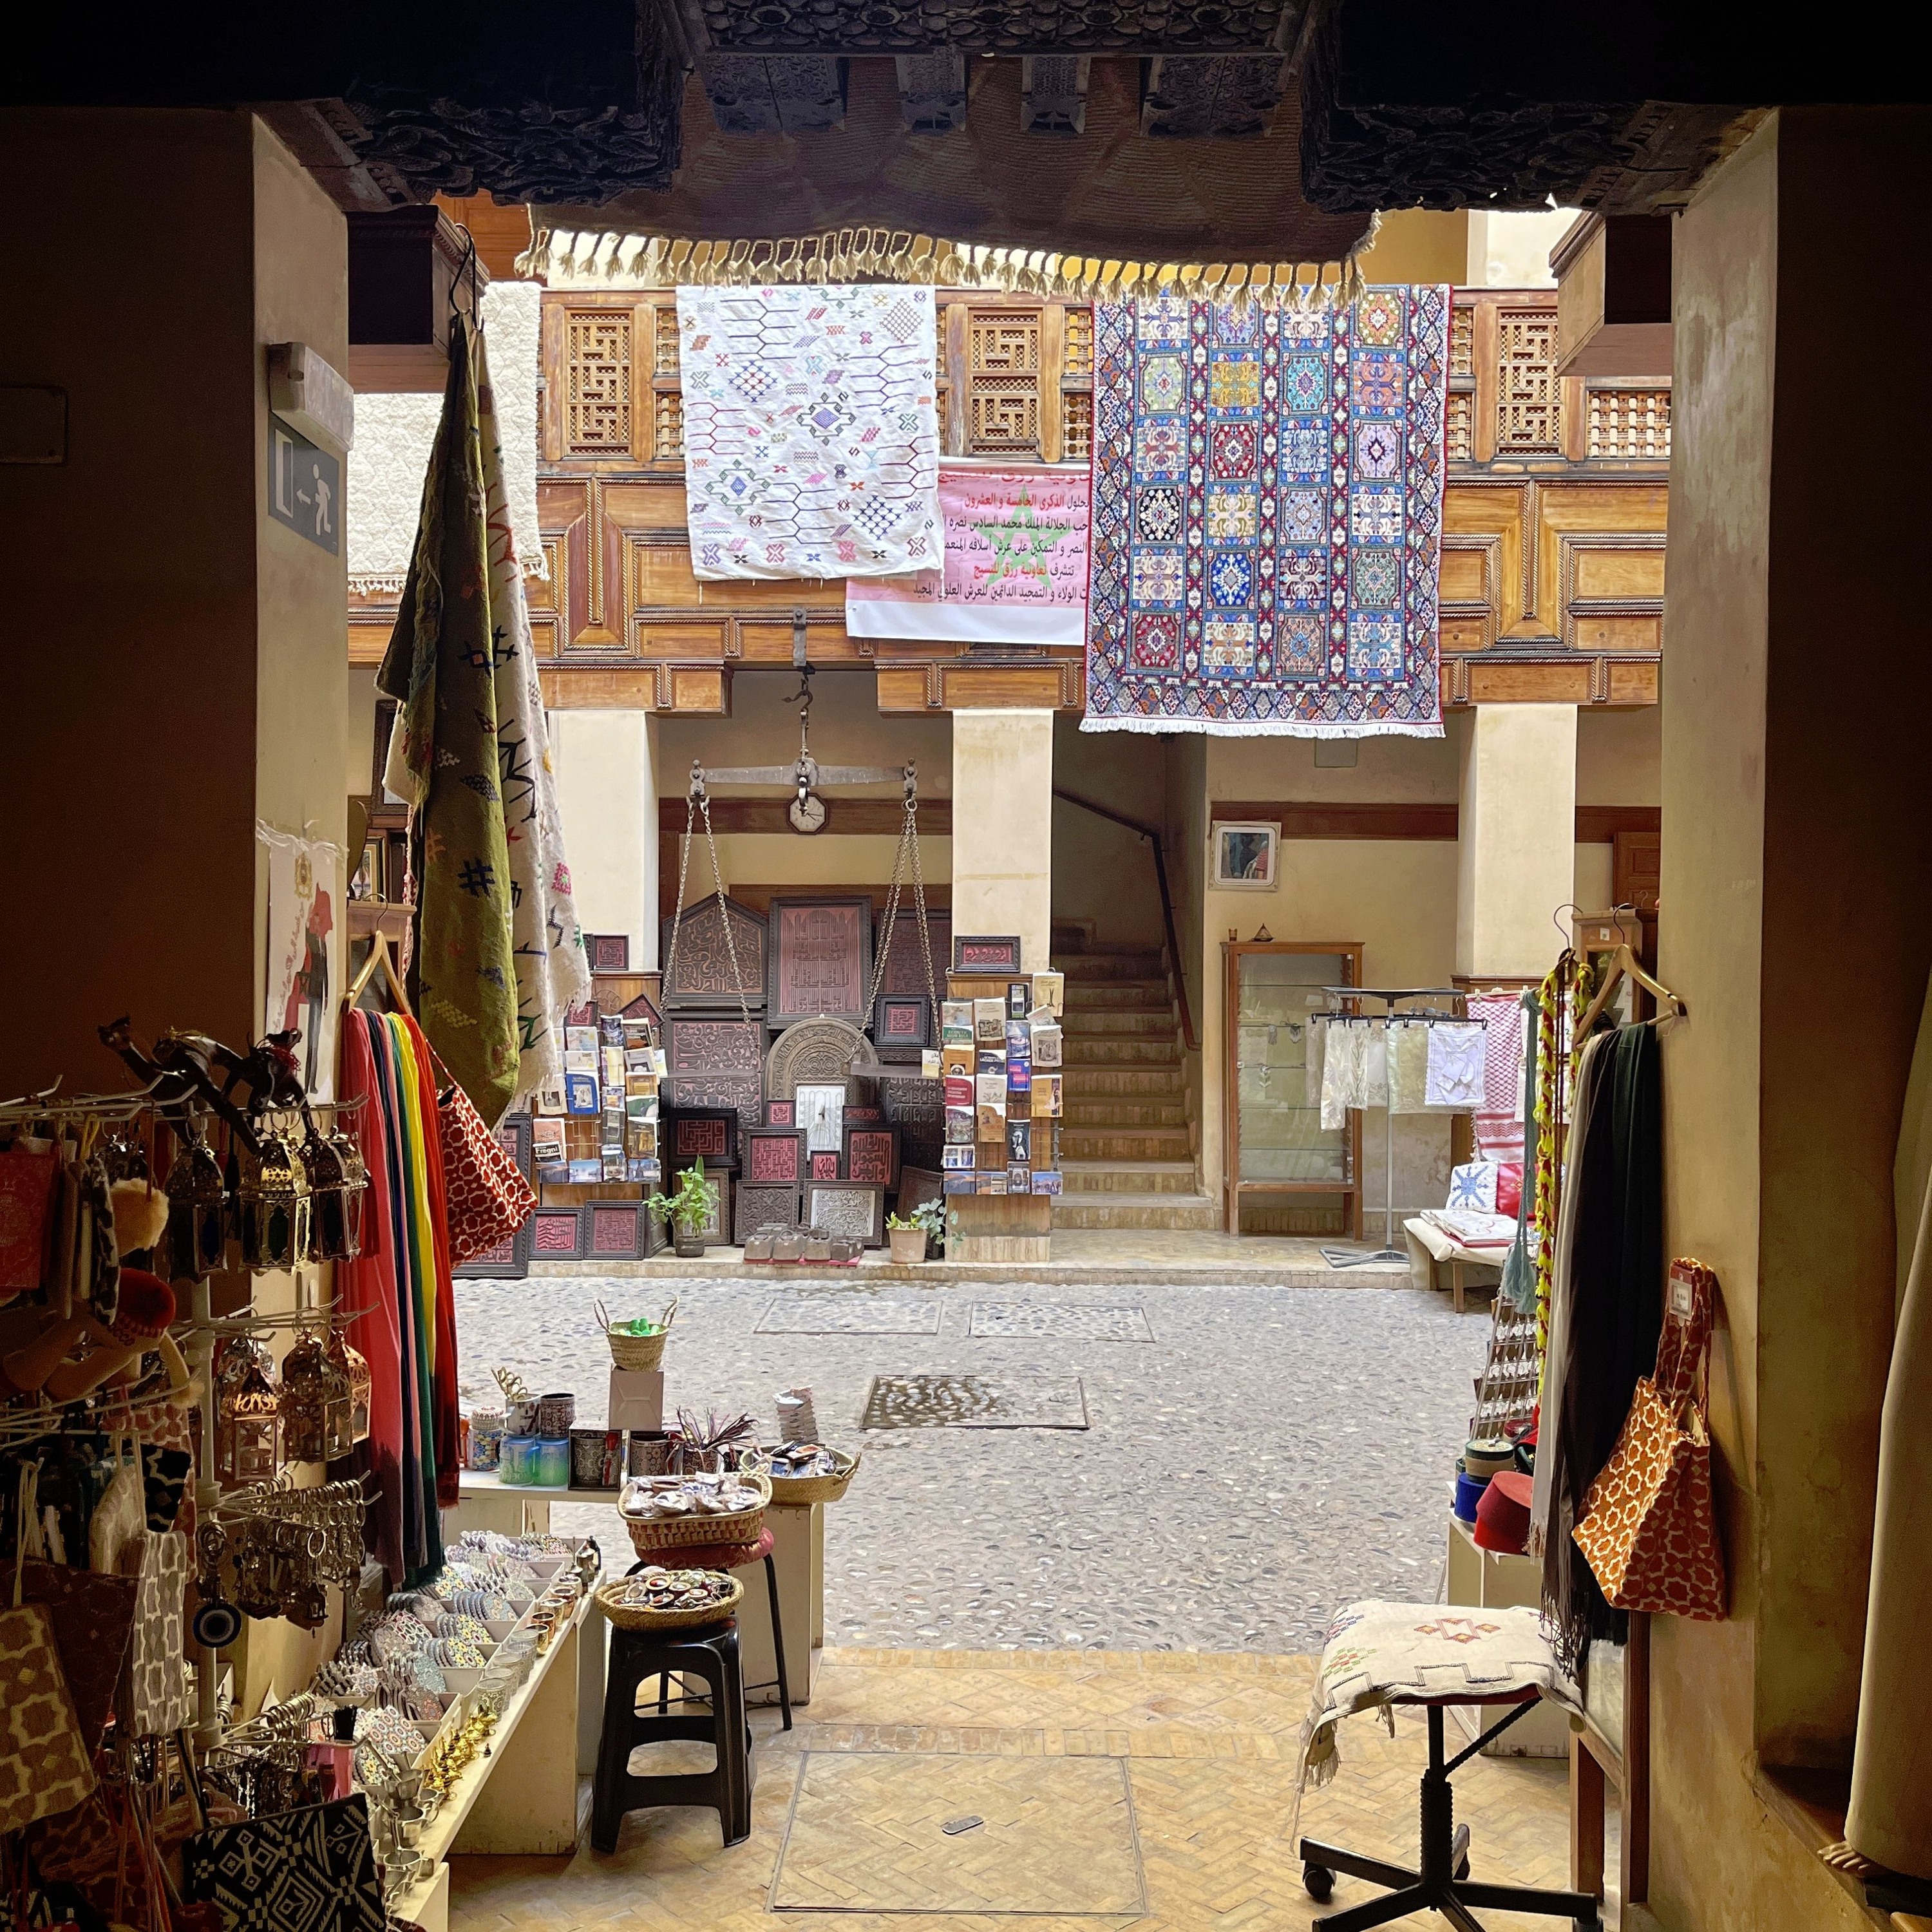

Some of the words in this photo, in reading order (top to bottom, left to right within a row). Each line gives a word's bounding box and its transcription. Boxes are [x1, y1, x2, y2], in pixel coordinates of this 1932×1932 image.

[965, 493, 996, 509] العشرون
[998, 497, 1003, 509] و
[1006, 493, 1036, 507] الخامسة
[950, 516, 967, 531] نصره
[970, 515, 998, 531] السادس
[1001, 518, 1022, 529] محمد
[1025, 516, 1043, 531] الملك
[1045, 516, 1070, 534] الجلالة
[945, 537, 966, 551] المنعم
[969, 534, 992, 551] أسلافه
[994, 539, 1012, 555] عرش
[1030, 538, 1057, 557] التمكين
[1059, 546, 1065, 556] و
[974, 561, 999, 580] للنسيج
[1002, 562, 1018, 578] رزق
[1021, 562, 1047, 579] تعاونية
[1050, 563, 1075, 580] تتشرف
[913, 582, 935, 598] المجيد
[937, 582, 962, 602] العلوي
[965, 583, 988, 600] للعرش
[990, 584, 1016, 601] الدائمين
[1019, 585, 1047, 602] التمجيد
[1050, 590, 1055, 602] و
[1057, 585, 1077, 603] الولاء
